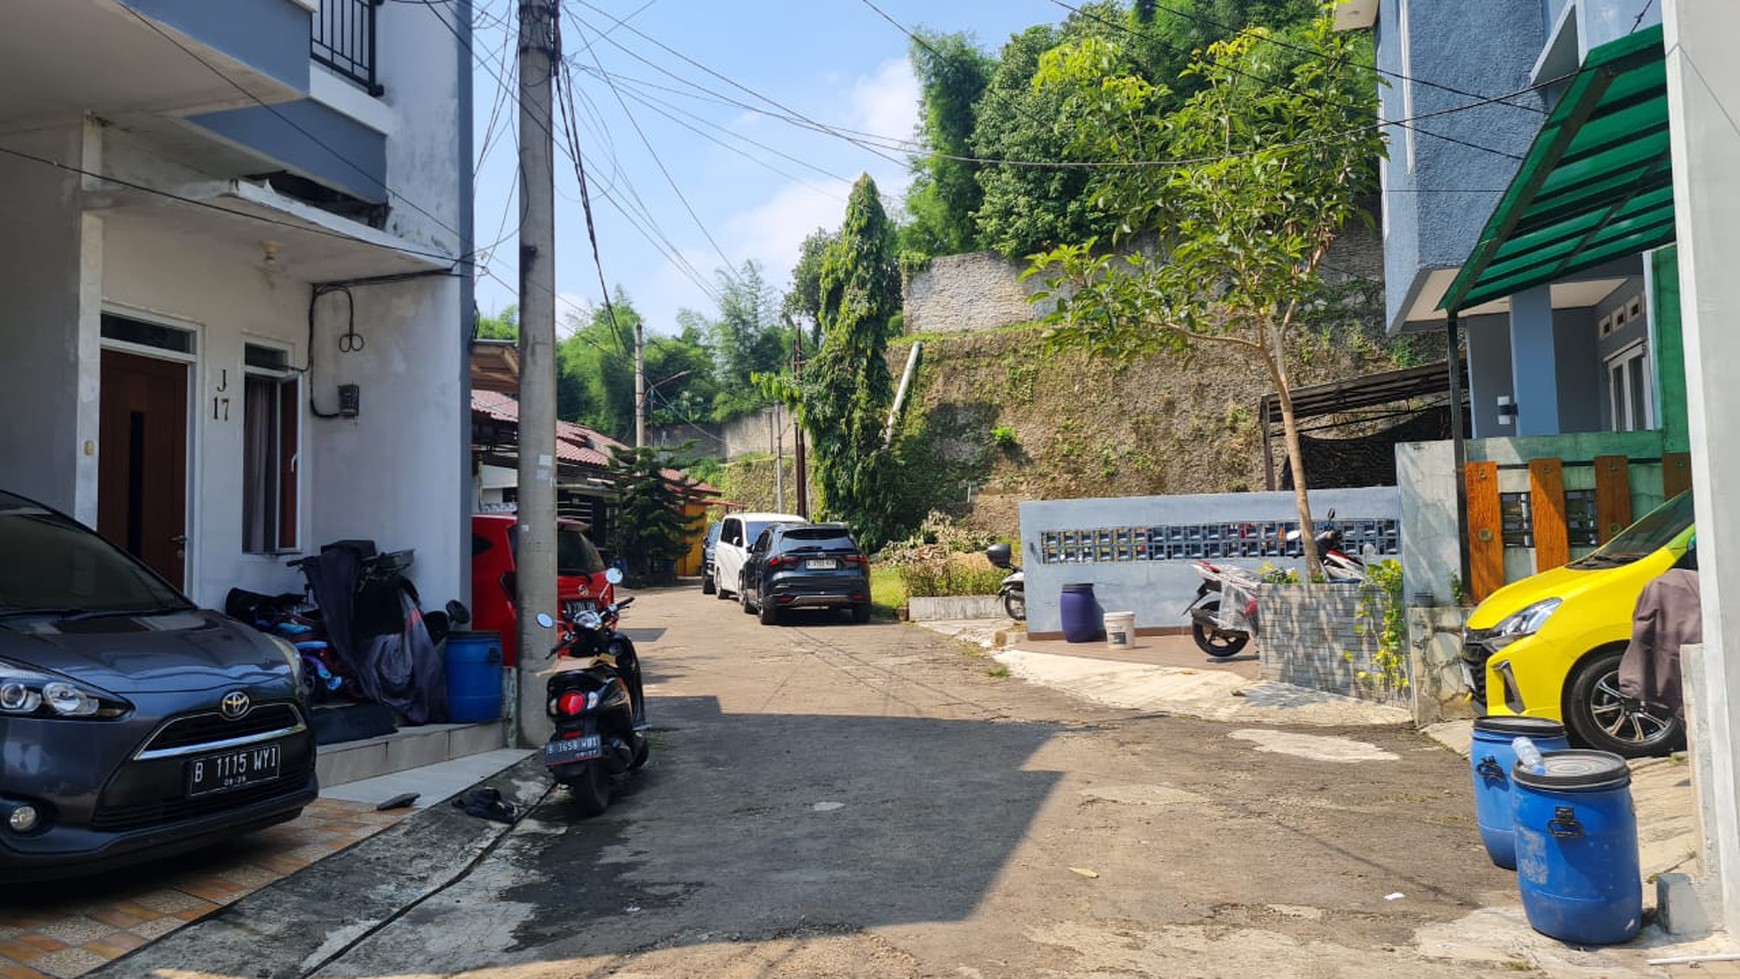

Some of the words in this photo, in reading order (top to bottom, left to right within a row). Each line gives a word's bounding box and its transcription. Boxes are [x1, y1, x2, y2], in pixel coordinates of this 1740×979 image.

[216, 368, 227, 392] J
[213, 396, 229, 422] 17
[194, 761, 204, 783] B
[217, 753, 247, 778] 1115
[253, 747, 276, 770] WYI
